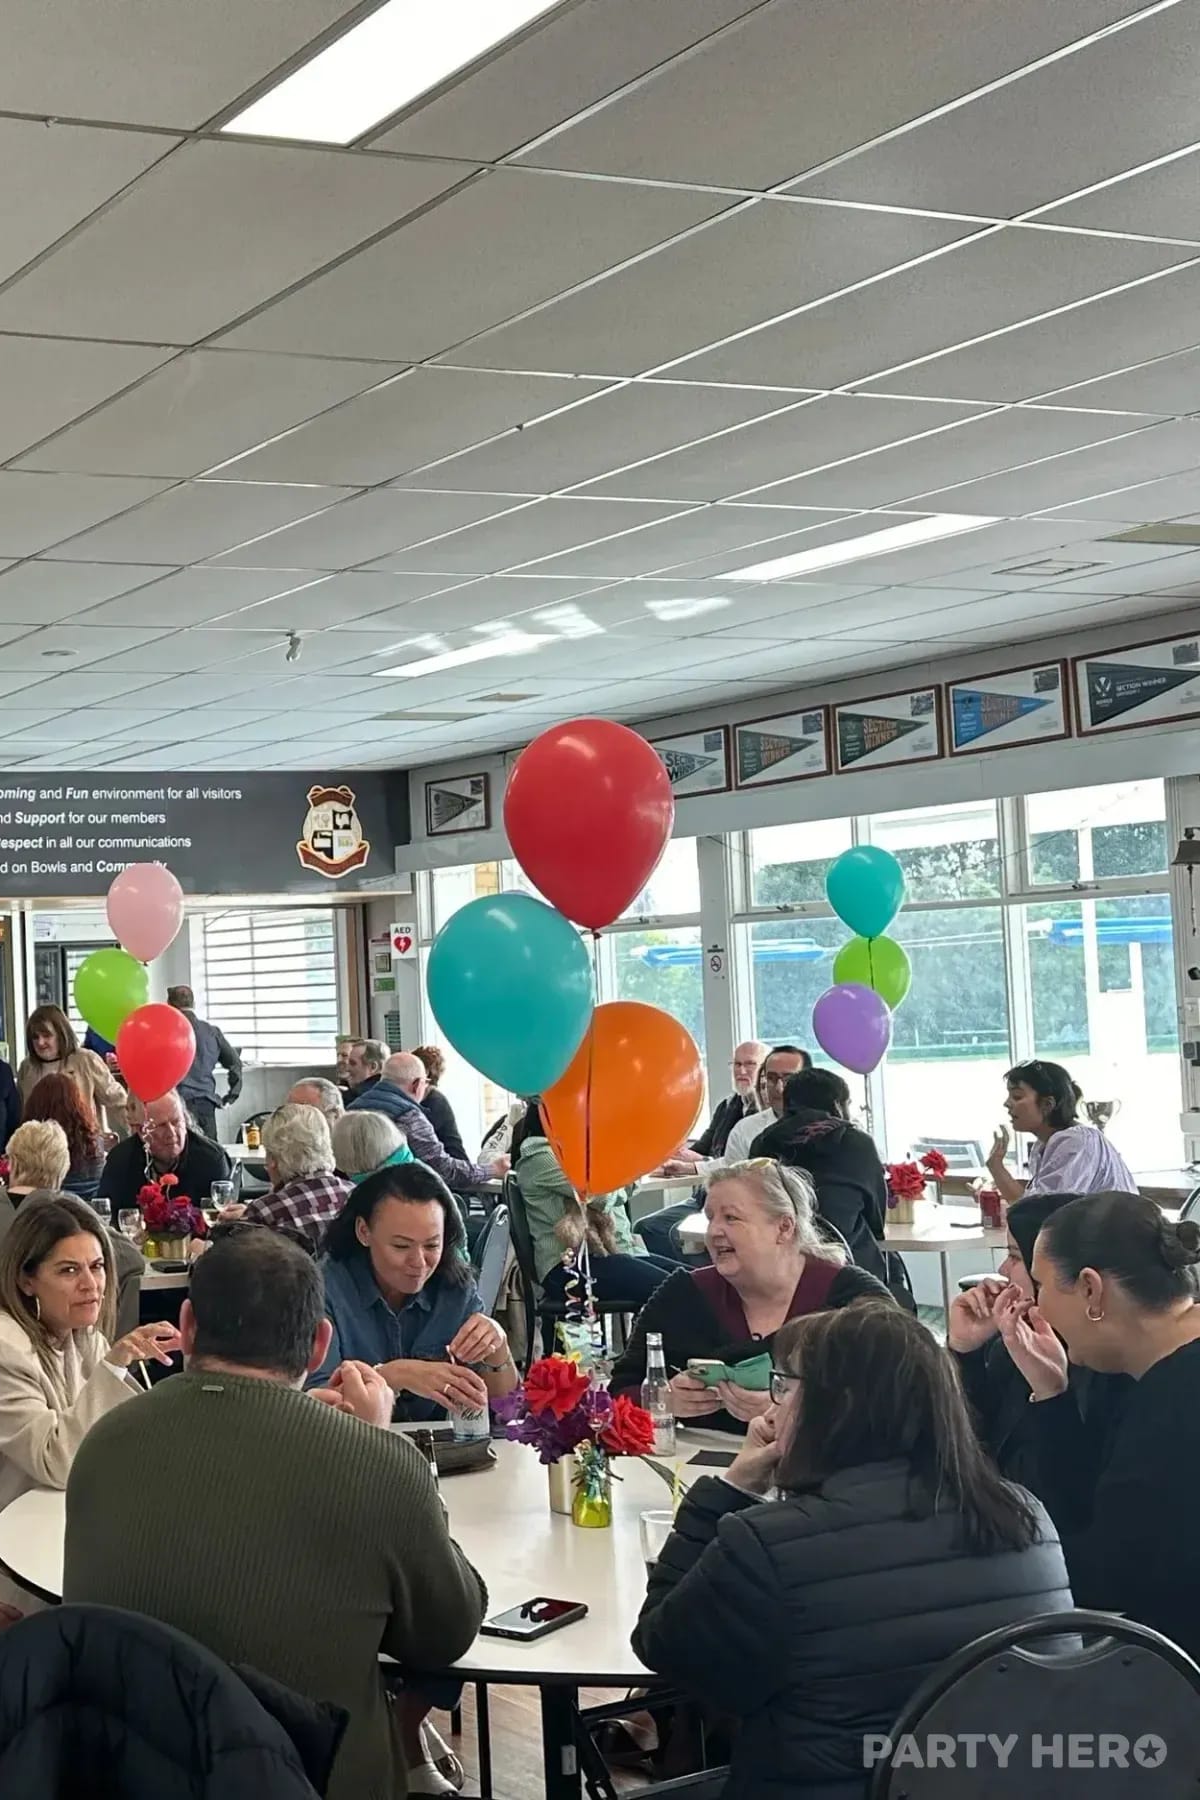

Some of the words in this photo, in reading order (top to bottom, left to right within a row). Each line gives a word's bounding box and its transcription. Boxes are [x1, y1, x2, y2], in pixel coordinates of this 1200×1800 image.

[39, 787, 63, 799] and
[65, 787, 88, 799] Fun
[92, 786, 165, 800] environment
[167, 786, 183, 799] for
[186, 787, 199, 799] all
[202, 787, 242, 800] visitors
[15, 811, 66, 826] Support
[68, 811, 85, 824] for
[87, 814, 107, 824] our
[111, 811, 166, 824] members
[46, 836, 56, 848] in
[59, 836, 72, 848] all
[75, 838, 95, 848] our
[98, 836, 192, 848] communications
[11, 864, 27, 873] on
[31, 861, 67, 873] Bowls
[70, 861, 93, 872] and
[394, 926, 411, 934] AED
